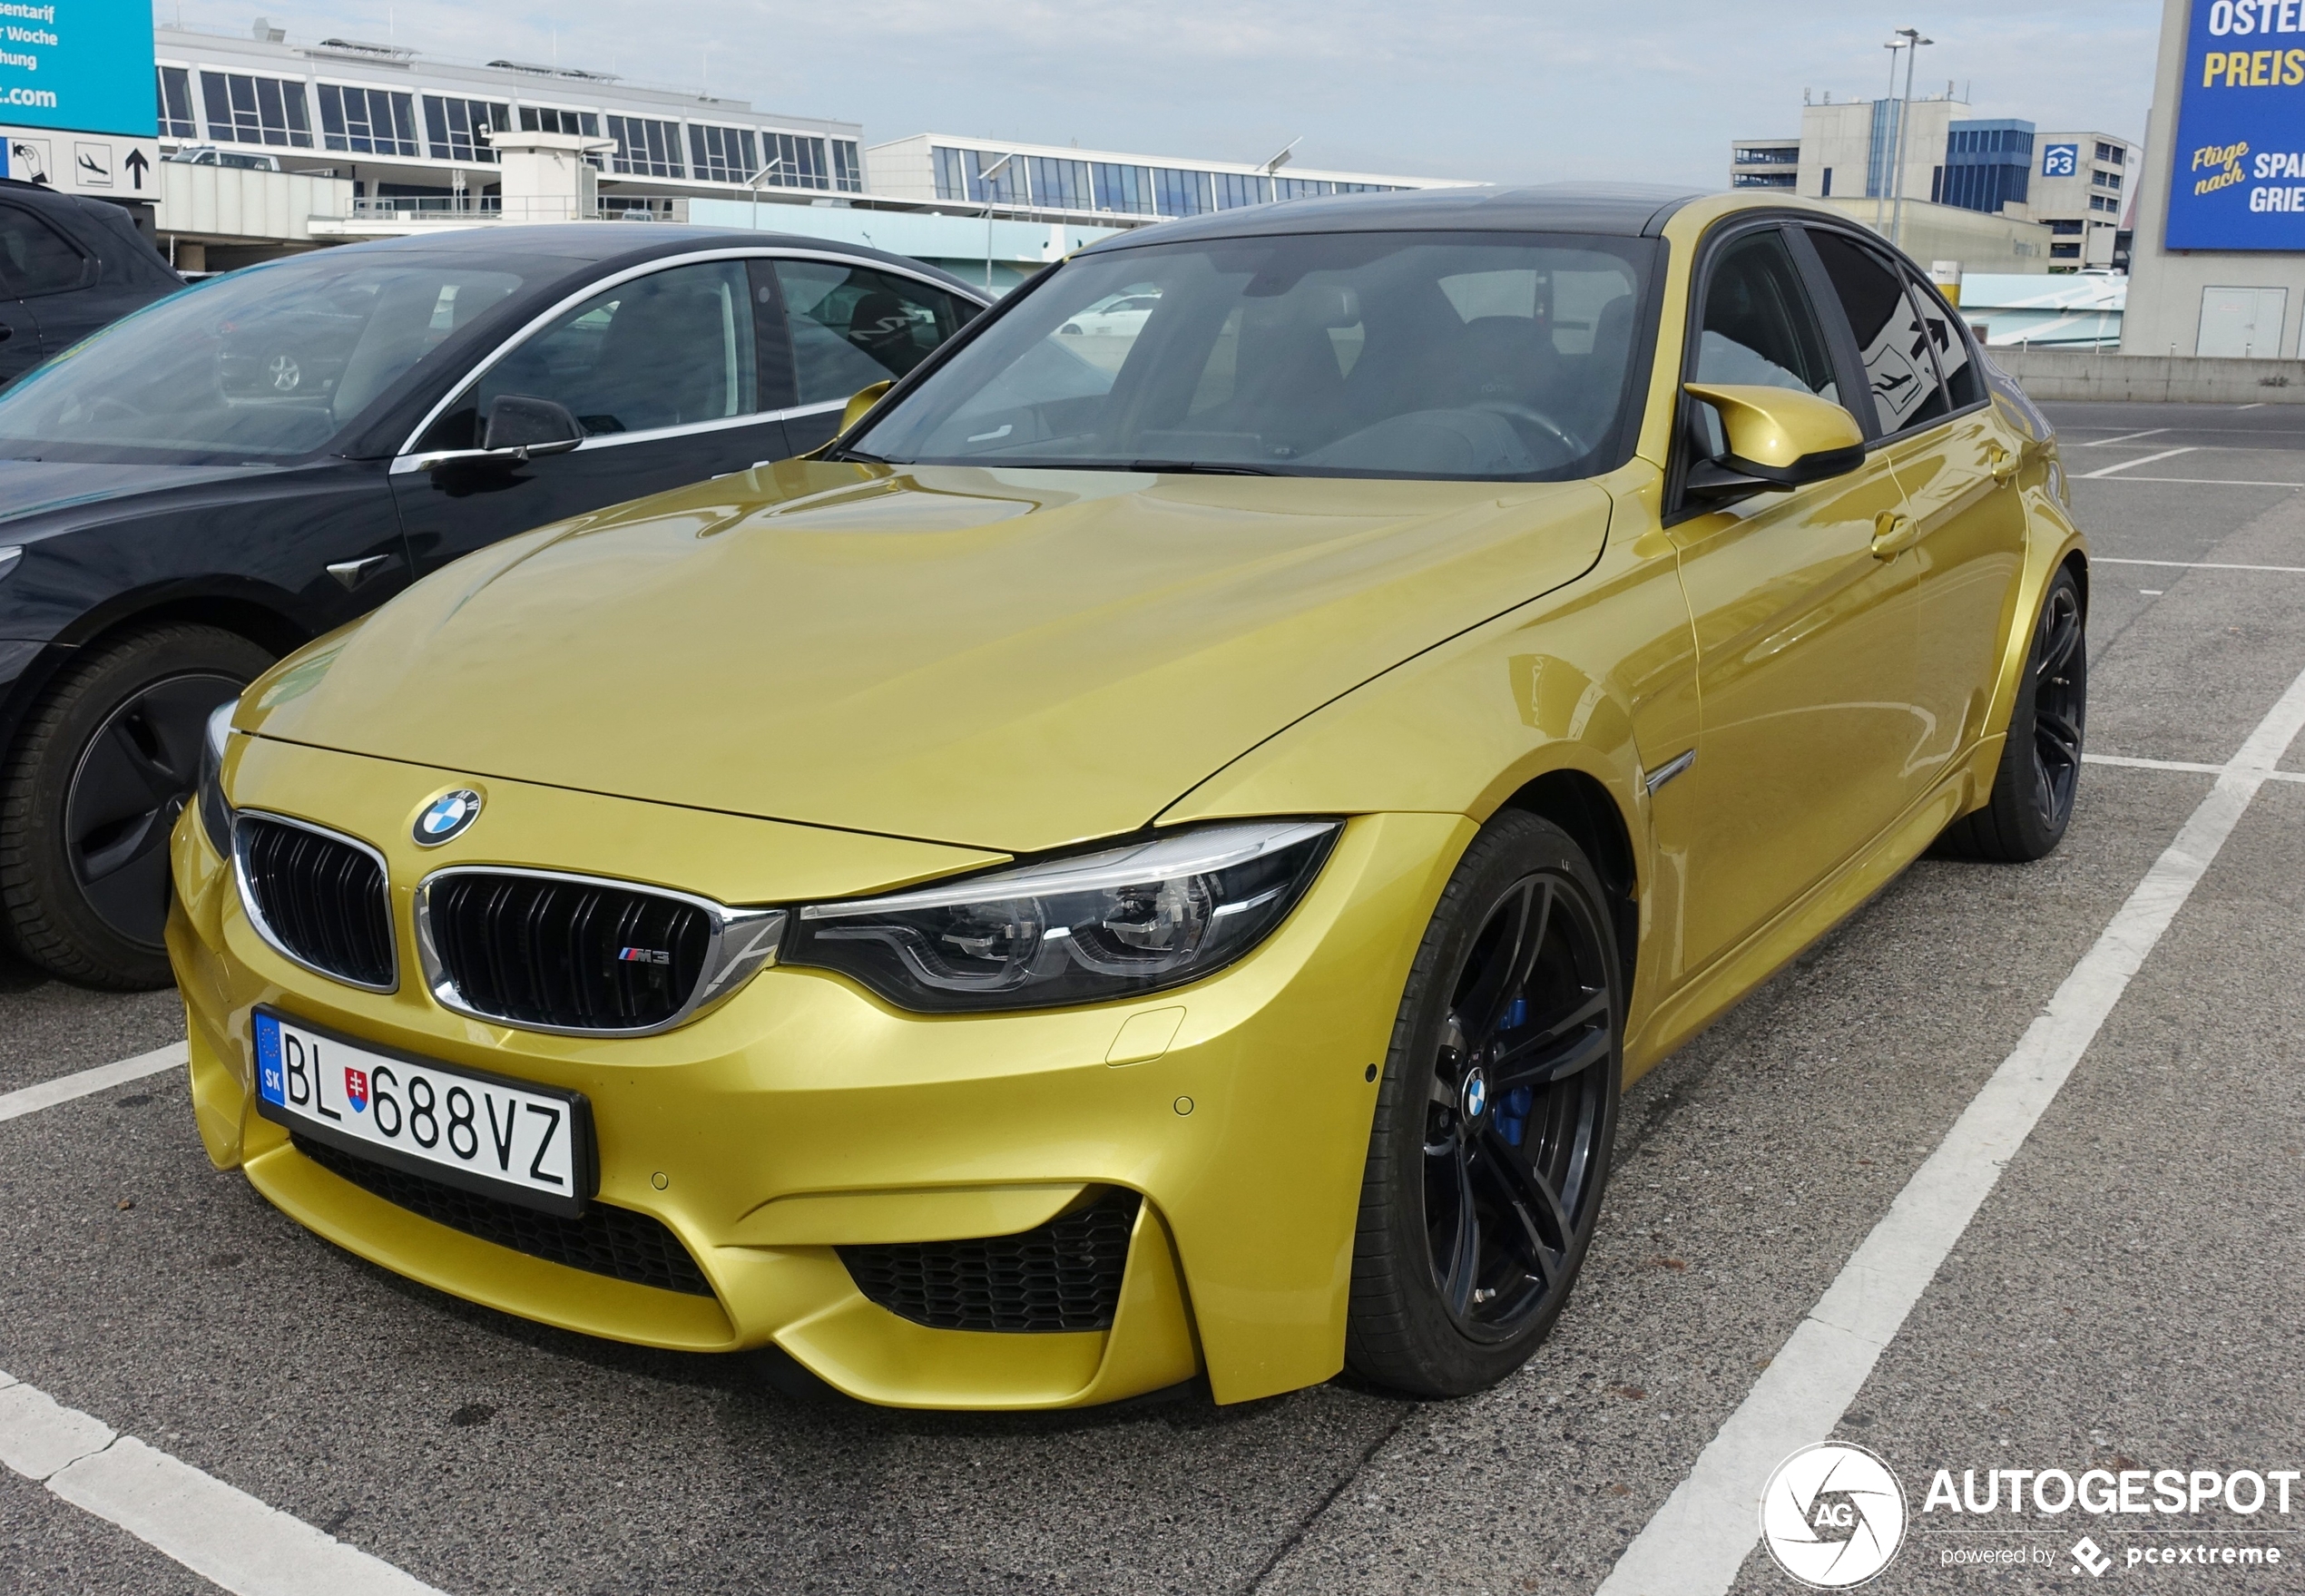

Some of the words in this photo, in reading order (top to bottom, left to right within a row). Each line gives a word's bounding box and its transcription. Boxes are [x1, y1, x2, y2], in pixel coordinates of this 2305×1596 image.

[6, 25, 58, 46] Woche
[2202, 49, 2305, 87] PREIS
[2045, 156, 2073, 174] P3
[2192, 142, 2249, 171] Flüge
[2194, 161, 2245, 196] nach
[436, 790, 478, 810] BMW
[634, 948, 670, 965] M3
[265, 1068, 280, 1092] SK
[285, 1033, 341, 1121] BL
[371, 1065, 564, 1187] 688VZ
